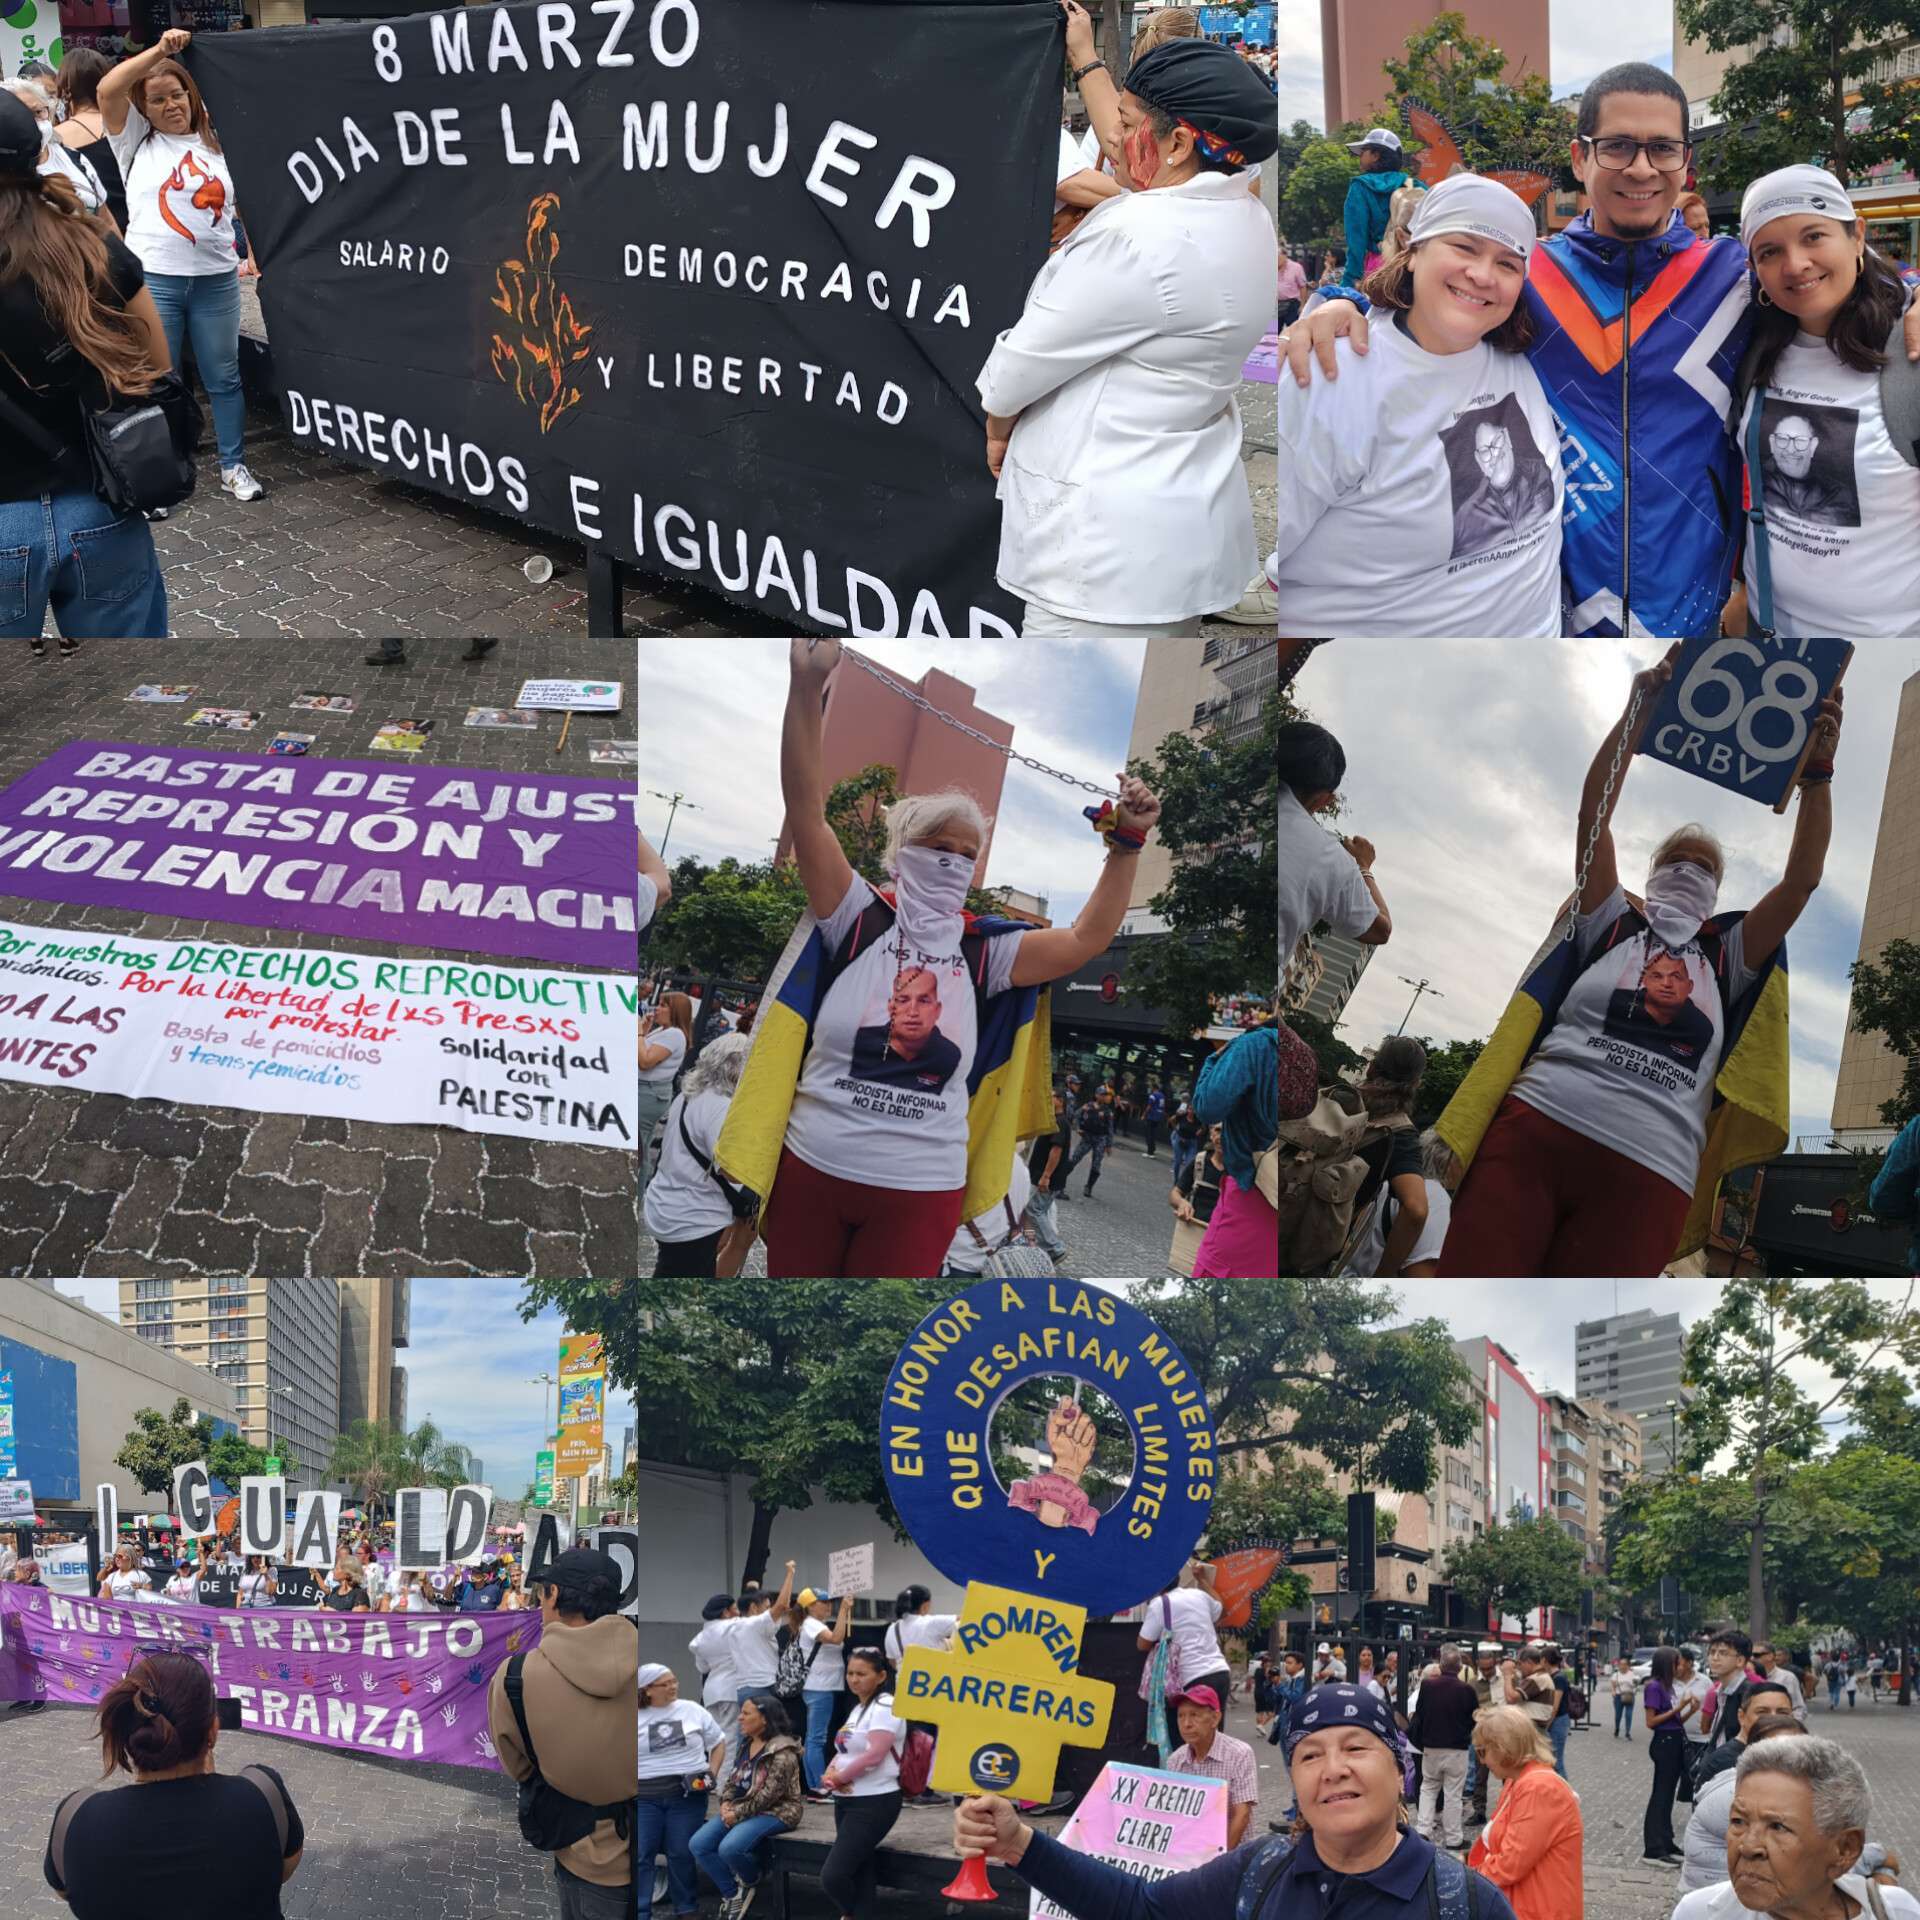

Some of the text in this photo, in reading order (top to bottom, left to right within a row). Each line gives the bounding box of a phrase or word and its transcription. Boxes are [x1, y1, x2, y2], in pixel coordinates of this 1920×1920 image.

[372, 0, 700, 83] 8 MARZO
[287, 99, 956, 247] DIA DE LA MUJER
[339, 241, 449, 274] SALARIO
[624, 243, 970, 328] DEMOCRACIA
[597, 352, 909, 425] Y LIBERTAD
[287, 390, 529, 513] DERECHOS
[570, 475, 602, 540] E
[1678, 638, 1819, 764] 68
[74, 751, 296, 794] BASTA
[312, 771, 416, 805] DE
[1654, 723, 1767, 784] CRBV
[20, 786, 563, 867] REPRESIÓN Y
[0, 826, 636, 932] VIOLENCIA MACH
[36, 939, 158, 971] nuestros
[166, 945, 360, 990] DERECHOS
[375, 963, 638, 1015] REPRODUCTIV
[119, 970, 176, 994] Por
[179, 974, 208, 997] la
[214, 981, 333, 1014] libertad
[341, 993, 381, 1018] de
[387, 998, 445, 1025] lxs
[452, 1000, 581, 1042] Presxs
[13, 993, 49, 1021] A
[50, 995, 126, 1034] LAS
[163, 1021, 229, 1045] Basta
[241, 1028, 266, 1050] de
[224, 1006, 267, 1022] por
[171, 1044, 184, 1063] y
[507, 1068, 552, 1089] con
[1586, 1036, 1649, 1064] PERIODISTA
[1650, 1057, 1697, 1092] INFORMAR
[1605, 1053, 1677, 1091] NO ES DELITO
[439, 1078, 631, 1142] PALESTINA
[834, 1077, 894, 1102] PERIODISTA
[896, 1092, 947, 1113] INFORMAR
[851, 1095, 925, 1120] NO ES DELITO
[1001, 1282, 1025, 1312] A
[1048, 1284, 1116, 1325] LAS
[889, 1299, 982, 1411] HONOR
[955, 1327, 1130, 1409] DESAFIAN
[1138, 1332, 1214, 1502] MUJERES
[889, 1425, 924, 1477] EN
[946, 1430, 984, 1510] QUE
[1127, 1403, 1169, 1540] LIMITES
[1033, 1549, 1056, 1580] Y
[49, 1595, 187, 1642] MUJER
[219, 1614, 483, 1659] TRABAJO
[957, 1606, 1080, 1674] ROMPEN
[907, 1670, 1096, 1727] BARRERAS
[1111, 1775, 1206, 1817] XX PREMIO
[1116, 1817, 1173, 1854] CLARA
